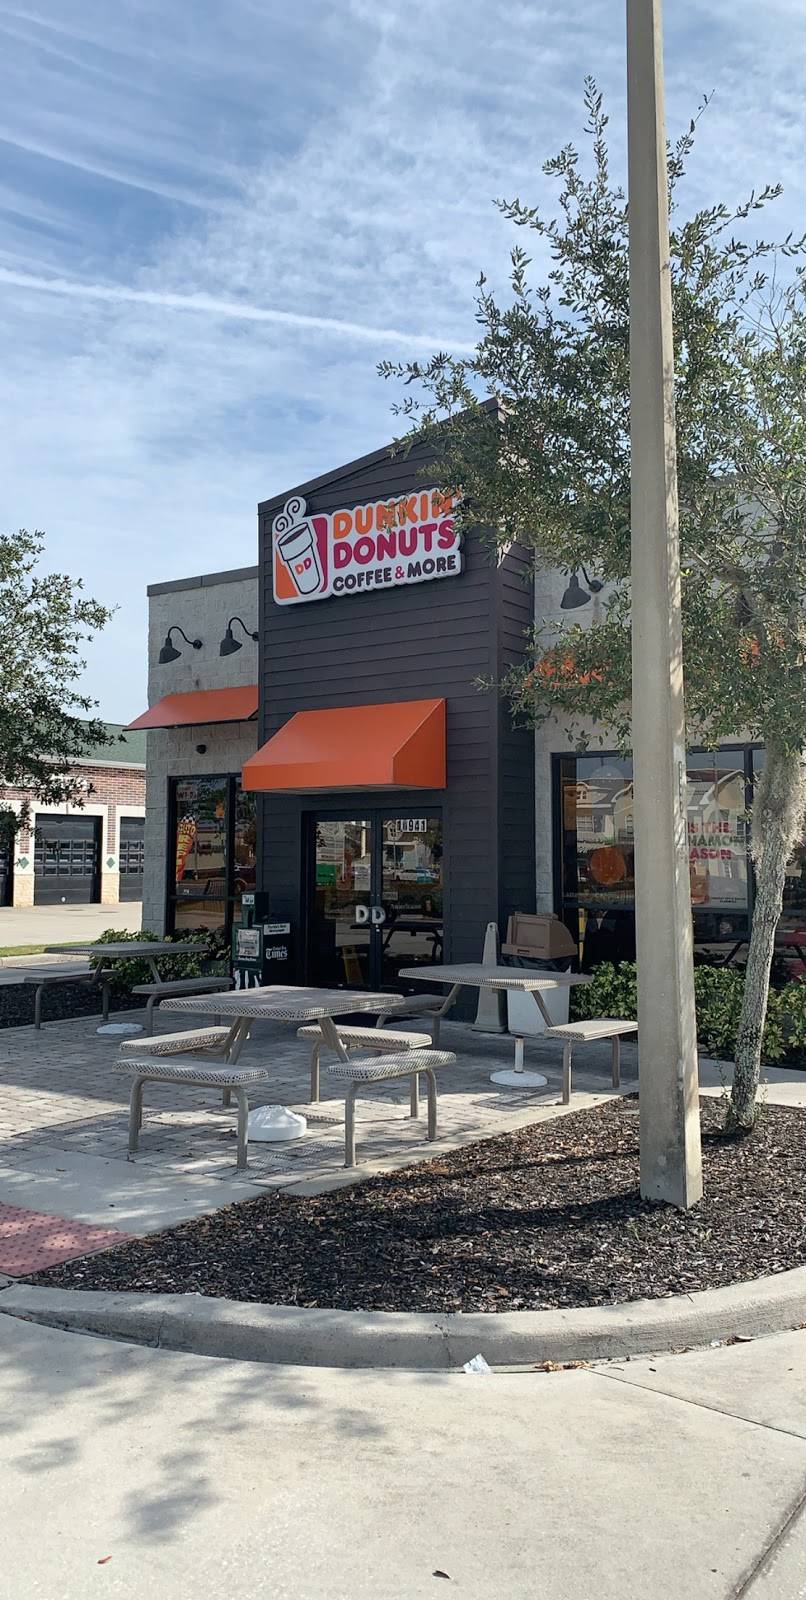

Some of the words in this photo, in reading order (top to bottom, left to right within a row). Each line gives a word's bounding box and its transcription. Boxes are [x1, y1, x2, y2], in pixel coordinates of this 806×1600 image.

[333, 520, 456, 569] DONUTS
[294, 556, 312, 576] DD
[333, 567, 392, 592] COFFEE
[395, 565, 405, 580] &
[407, 554, 456, 578] MORE
[396, 819, 426, 832] 10941
[690, 847, 732, 860] ASON
[355, 904, 386, 924] DD
[265, 947, 288, 960] Times
